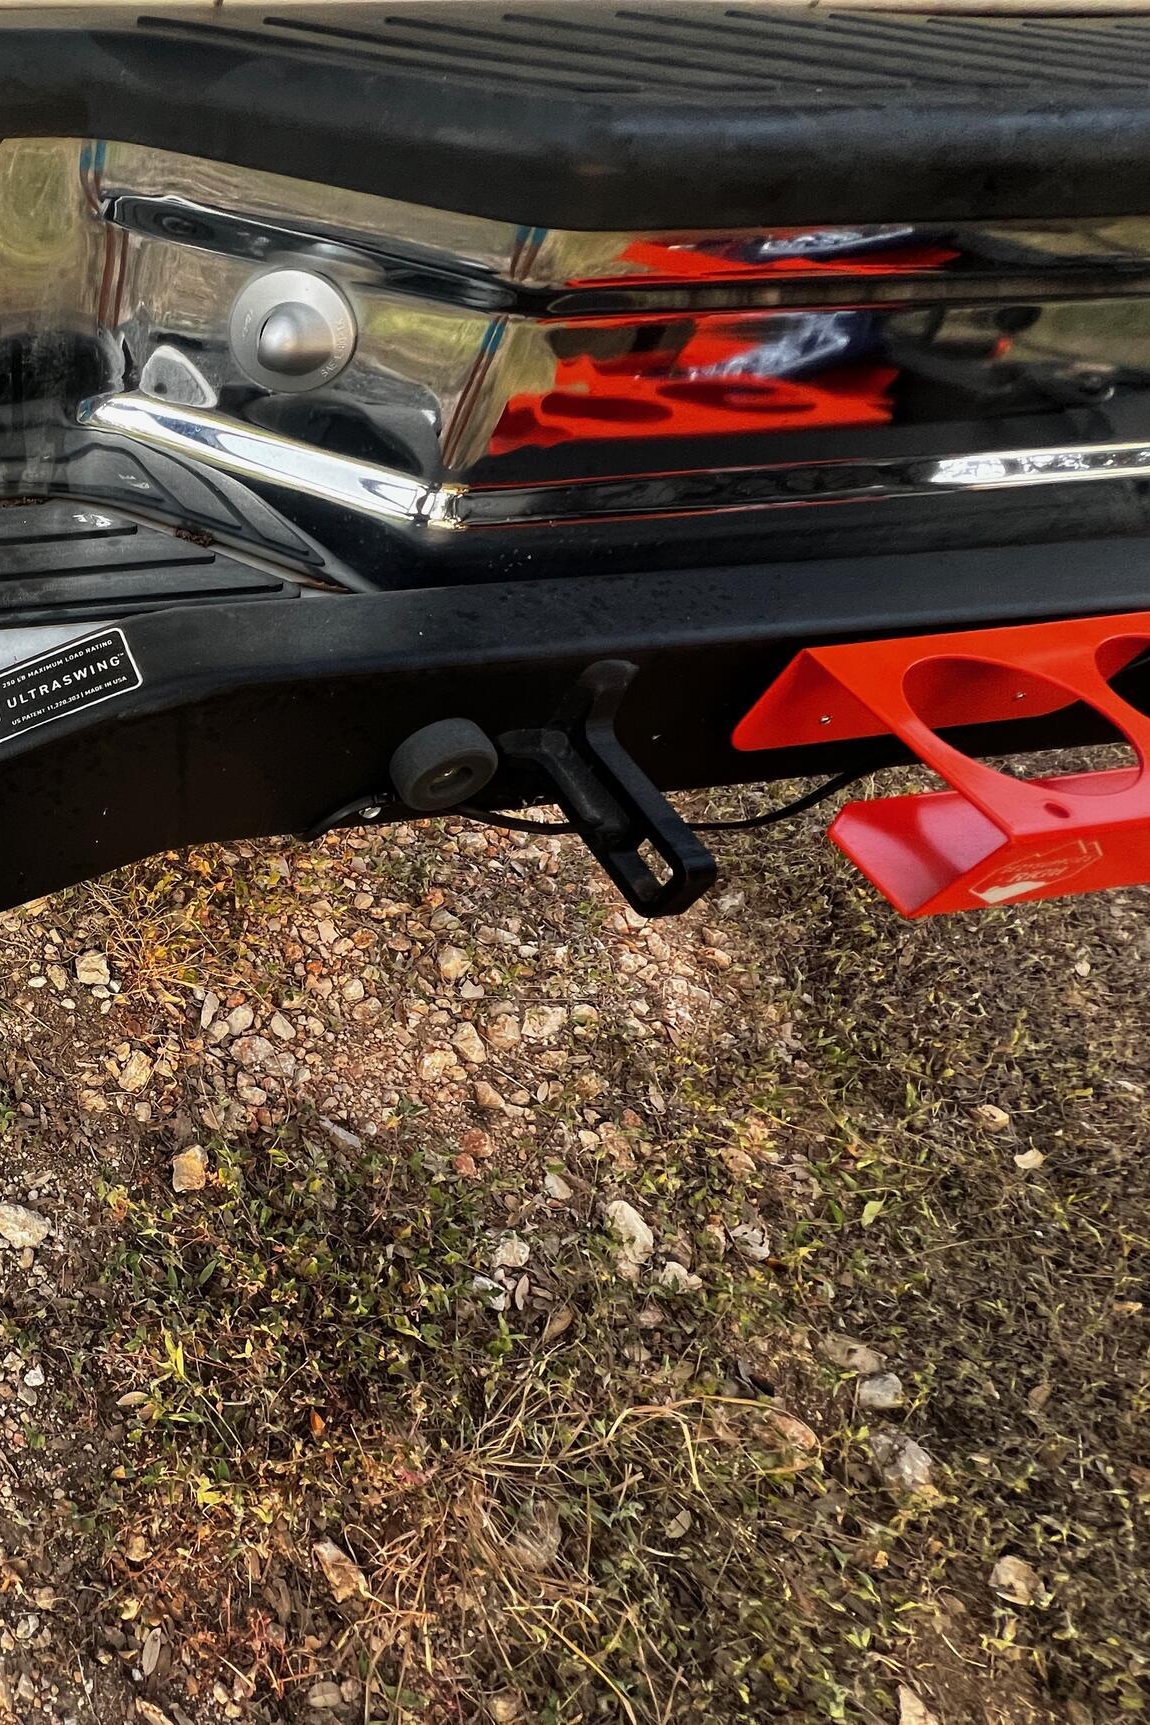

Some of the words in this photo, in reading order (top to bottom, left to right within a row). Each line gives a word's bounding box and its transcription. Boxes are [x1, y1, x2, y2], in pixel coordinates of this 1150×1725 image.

[17, 674, 26, 683] LB
[27, 659, 63, 678] MAXIMUM
[65, 650, 84, 662] LOAD
[85, 639, 113, 654] RATING
[11, 718, 22, 726] US
[22, 708, 46, 722] PATENT
[84, 684, 103, 696] MADE
[104, 680, 112, 688] IN
[113, 676, 128, 685] USA
